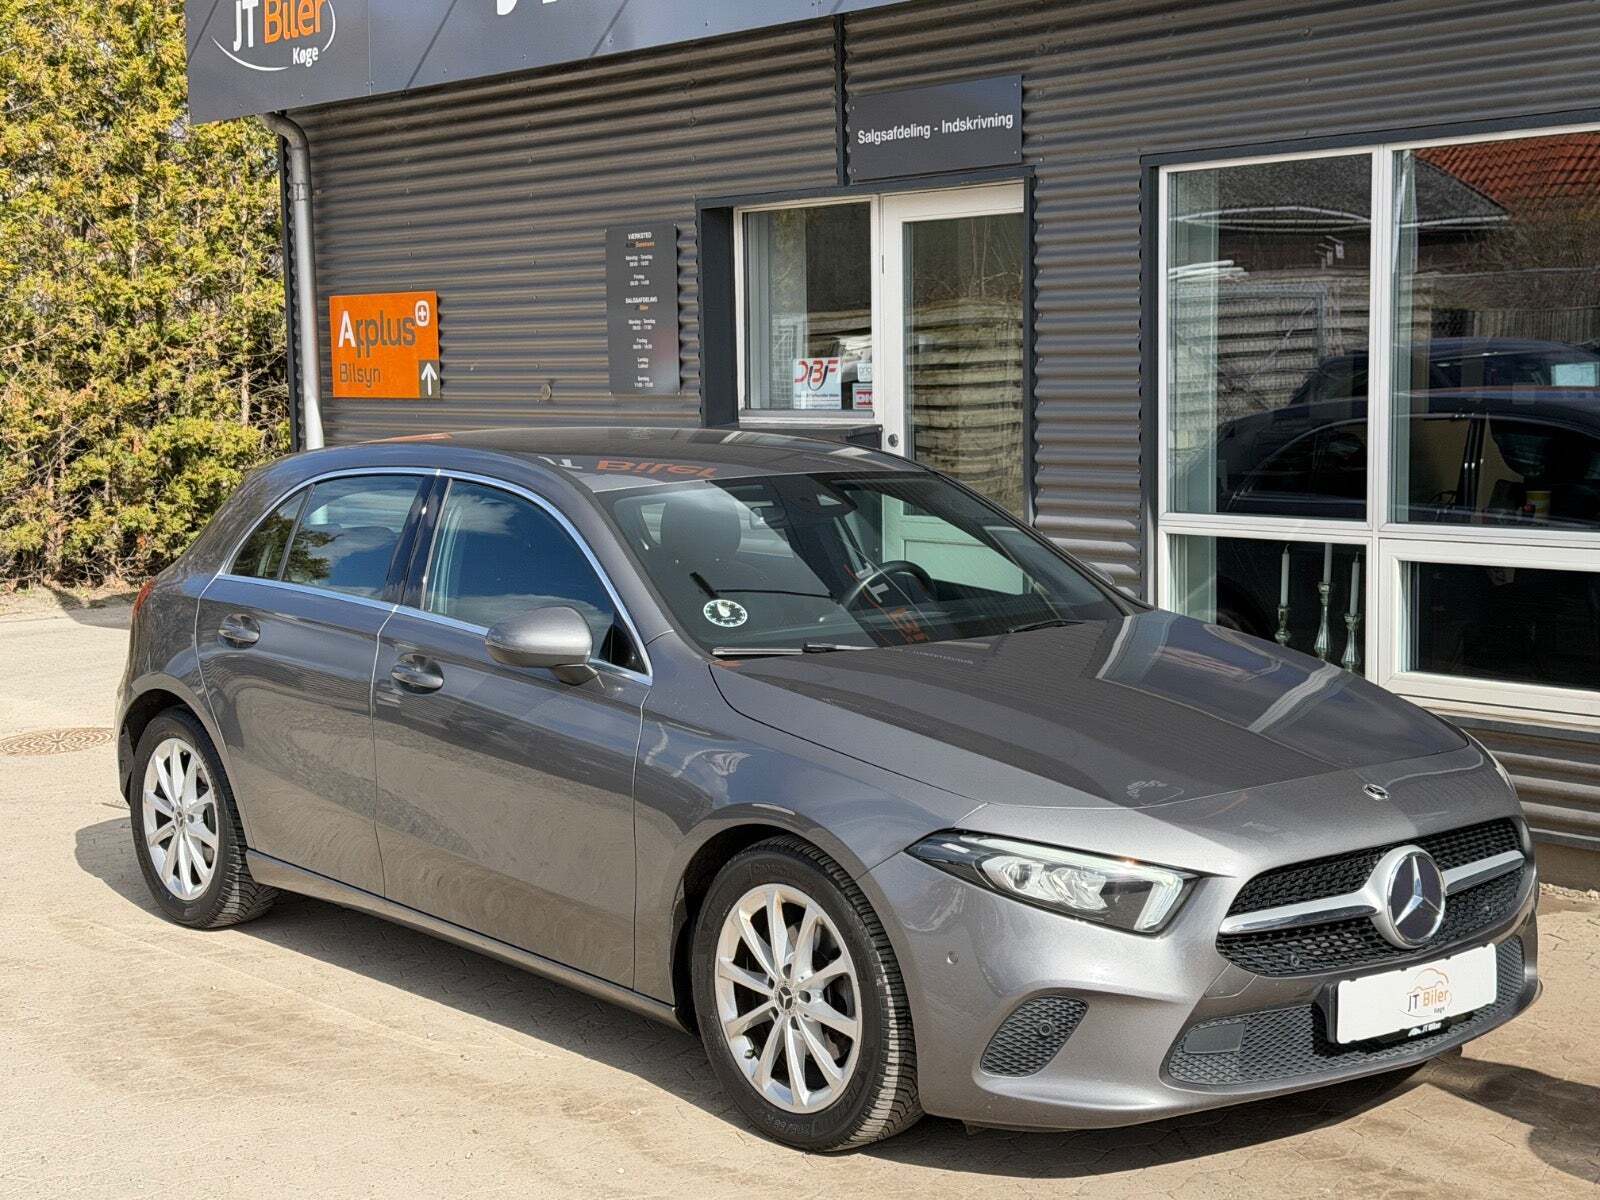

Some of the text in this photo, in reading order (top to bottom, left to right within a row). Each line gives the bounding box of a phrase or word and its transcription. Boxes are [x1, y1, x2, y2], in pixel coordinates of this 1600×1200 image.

[233, 0, 326, 51] JT Biler
[292, 46, 319, 67] Køge
[857, 123, 931, 145] Salgsafdeling
[941, 112, 1013, 134] Indskrivning
[339, 362, 381, 388] Bilsyn
[1407, 989, 1449, 1012] JT Biler
